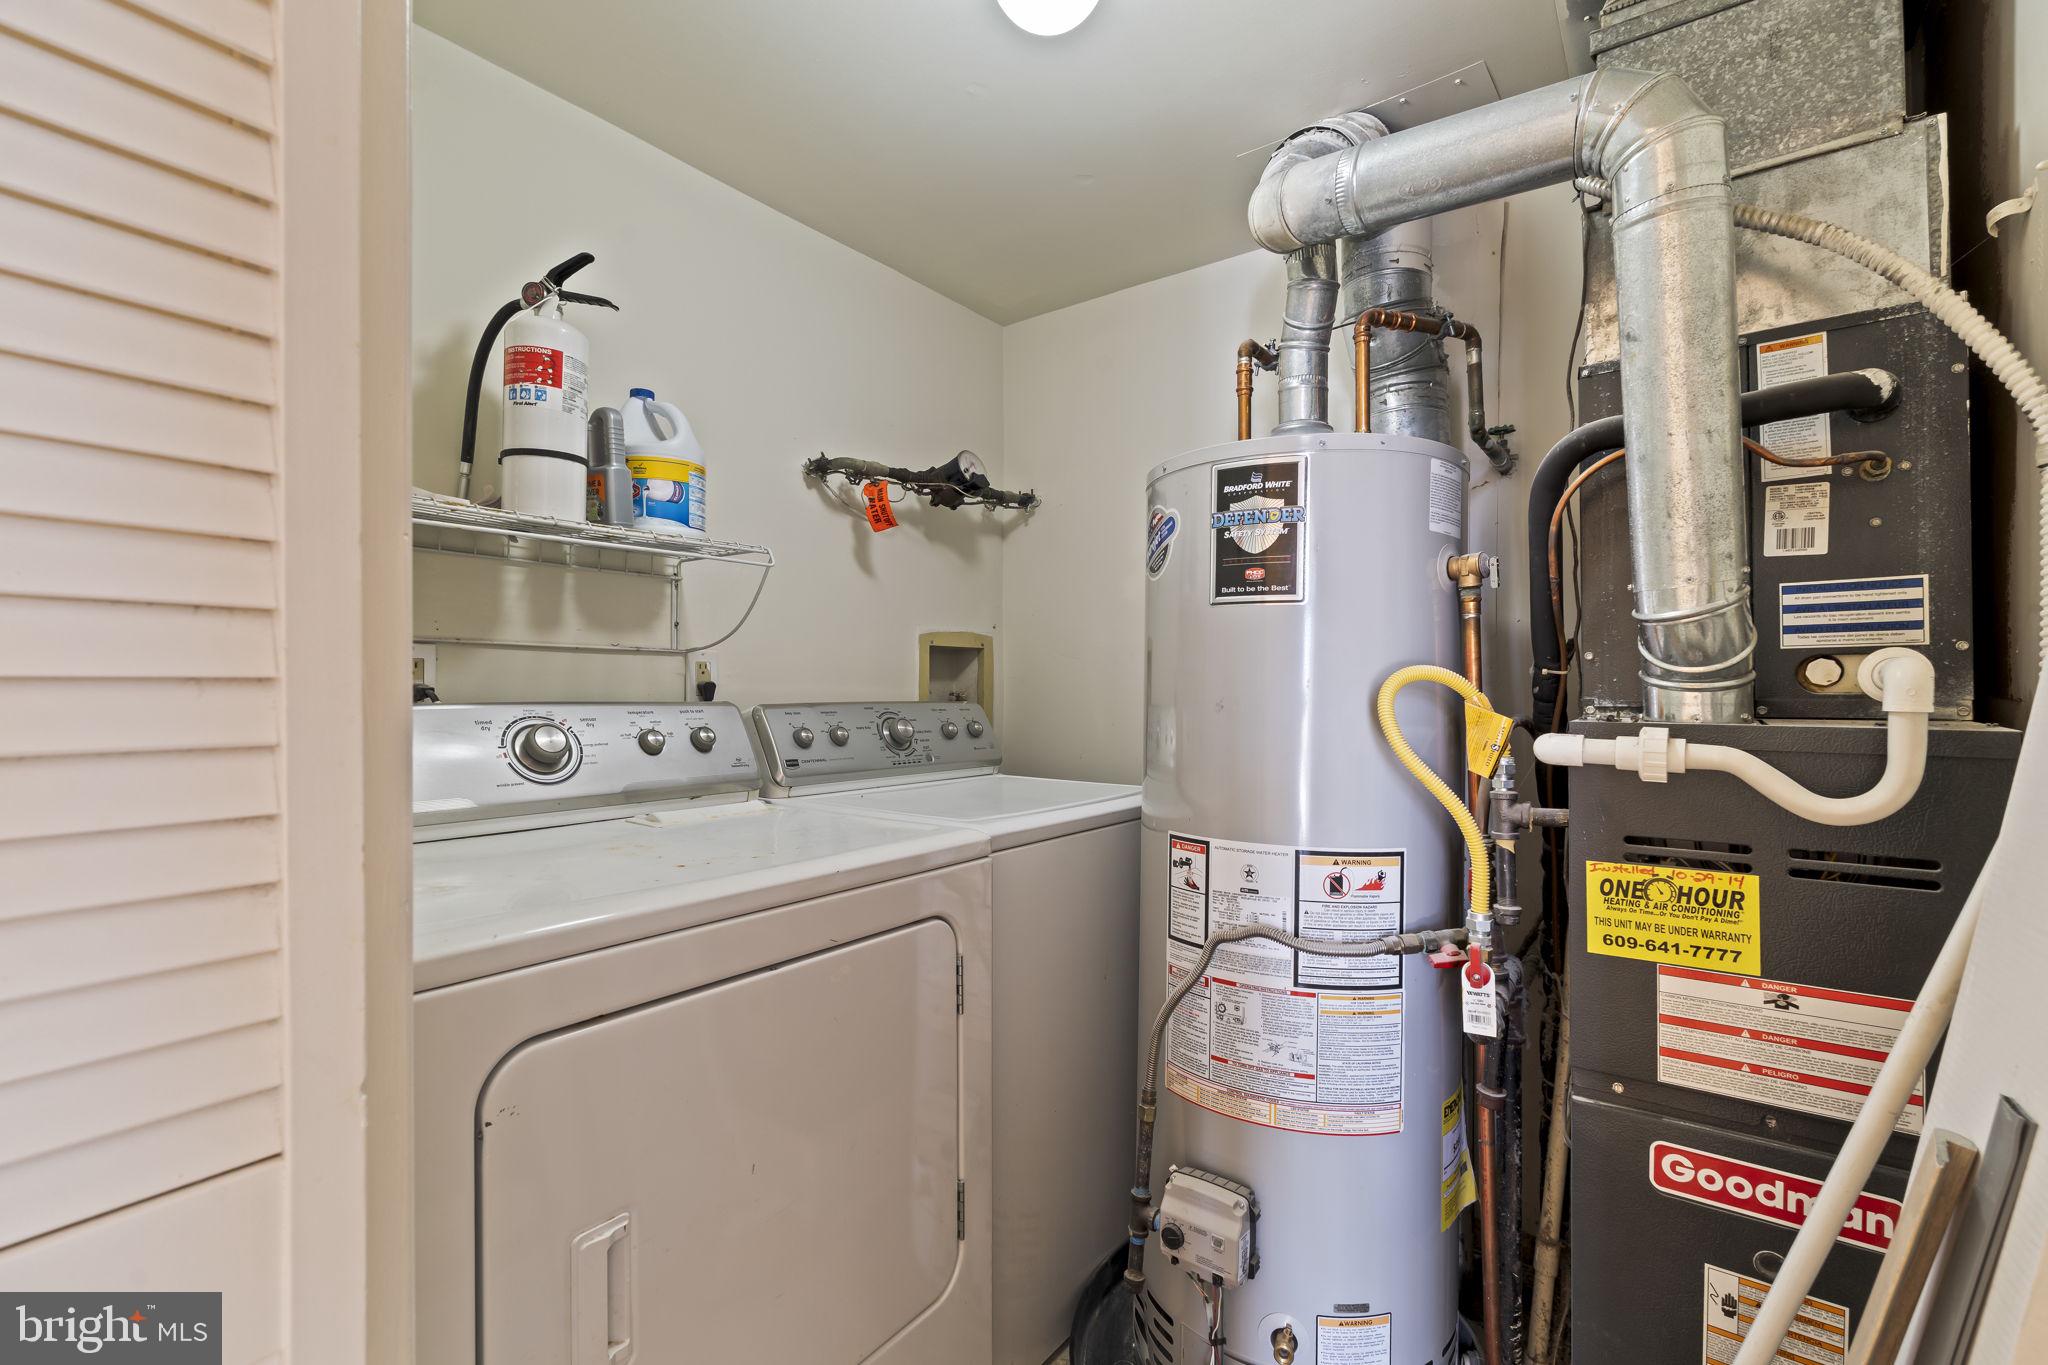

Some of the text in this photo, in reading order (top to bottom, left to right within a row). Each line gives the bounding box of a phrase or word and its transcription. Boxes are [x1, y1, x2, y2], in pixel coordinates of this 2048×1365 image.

[1779, 338, 1809, 349] WARNING
[508, 346, 552, 355] INSTRUCTIONS
[1224, 480, 1291, 494] BRADFORD WHITE
[1212, 506, 1306, 530] DEFENDER
[1224, 530, 1252, 539] SAFETY
[1221, 586, 1236, 594] Built
[1181, 844, 1201, 852] DANGER
[1600, 878, 1746, 910] ONE HOUR
[1603, 897, 1642, 909] HEATING
[1654, 902, 1668, 912] AIR
[1671, 904, 1741, 919] CONDITIONING
[1606, 904, 1627, 914] Always
[1669, 912, 1682, 920] You
[1682, 913, 1699, 922] Don't
[1700, 916, 1713, 924] Pay
[1594, 916, 1752, 944] THIS UNIT MAY BE UNDER WARRANTY
[1602, 934, 1742, 963] 609-641-7777
[1762, 982, 1798, 994] DANGER
[1762, 1034, 1798, 1046] DANGER
[1762, 1068, 1799, 1080] PELIGRO
[1661, 1153, 1894, 1239] Goodman
